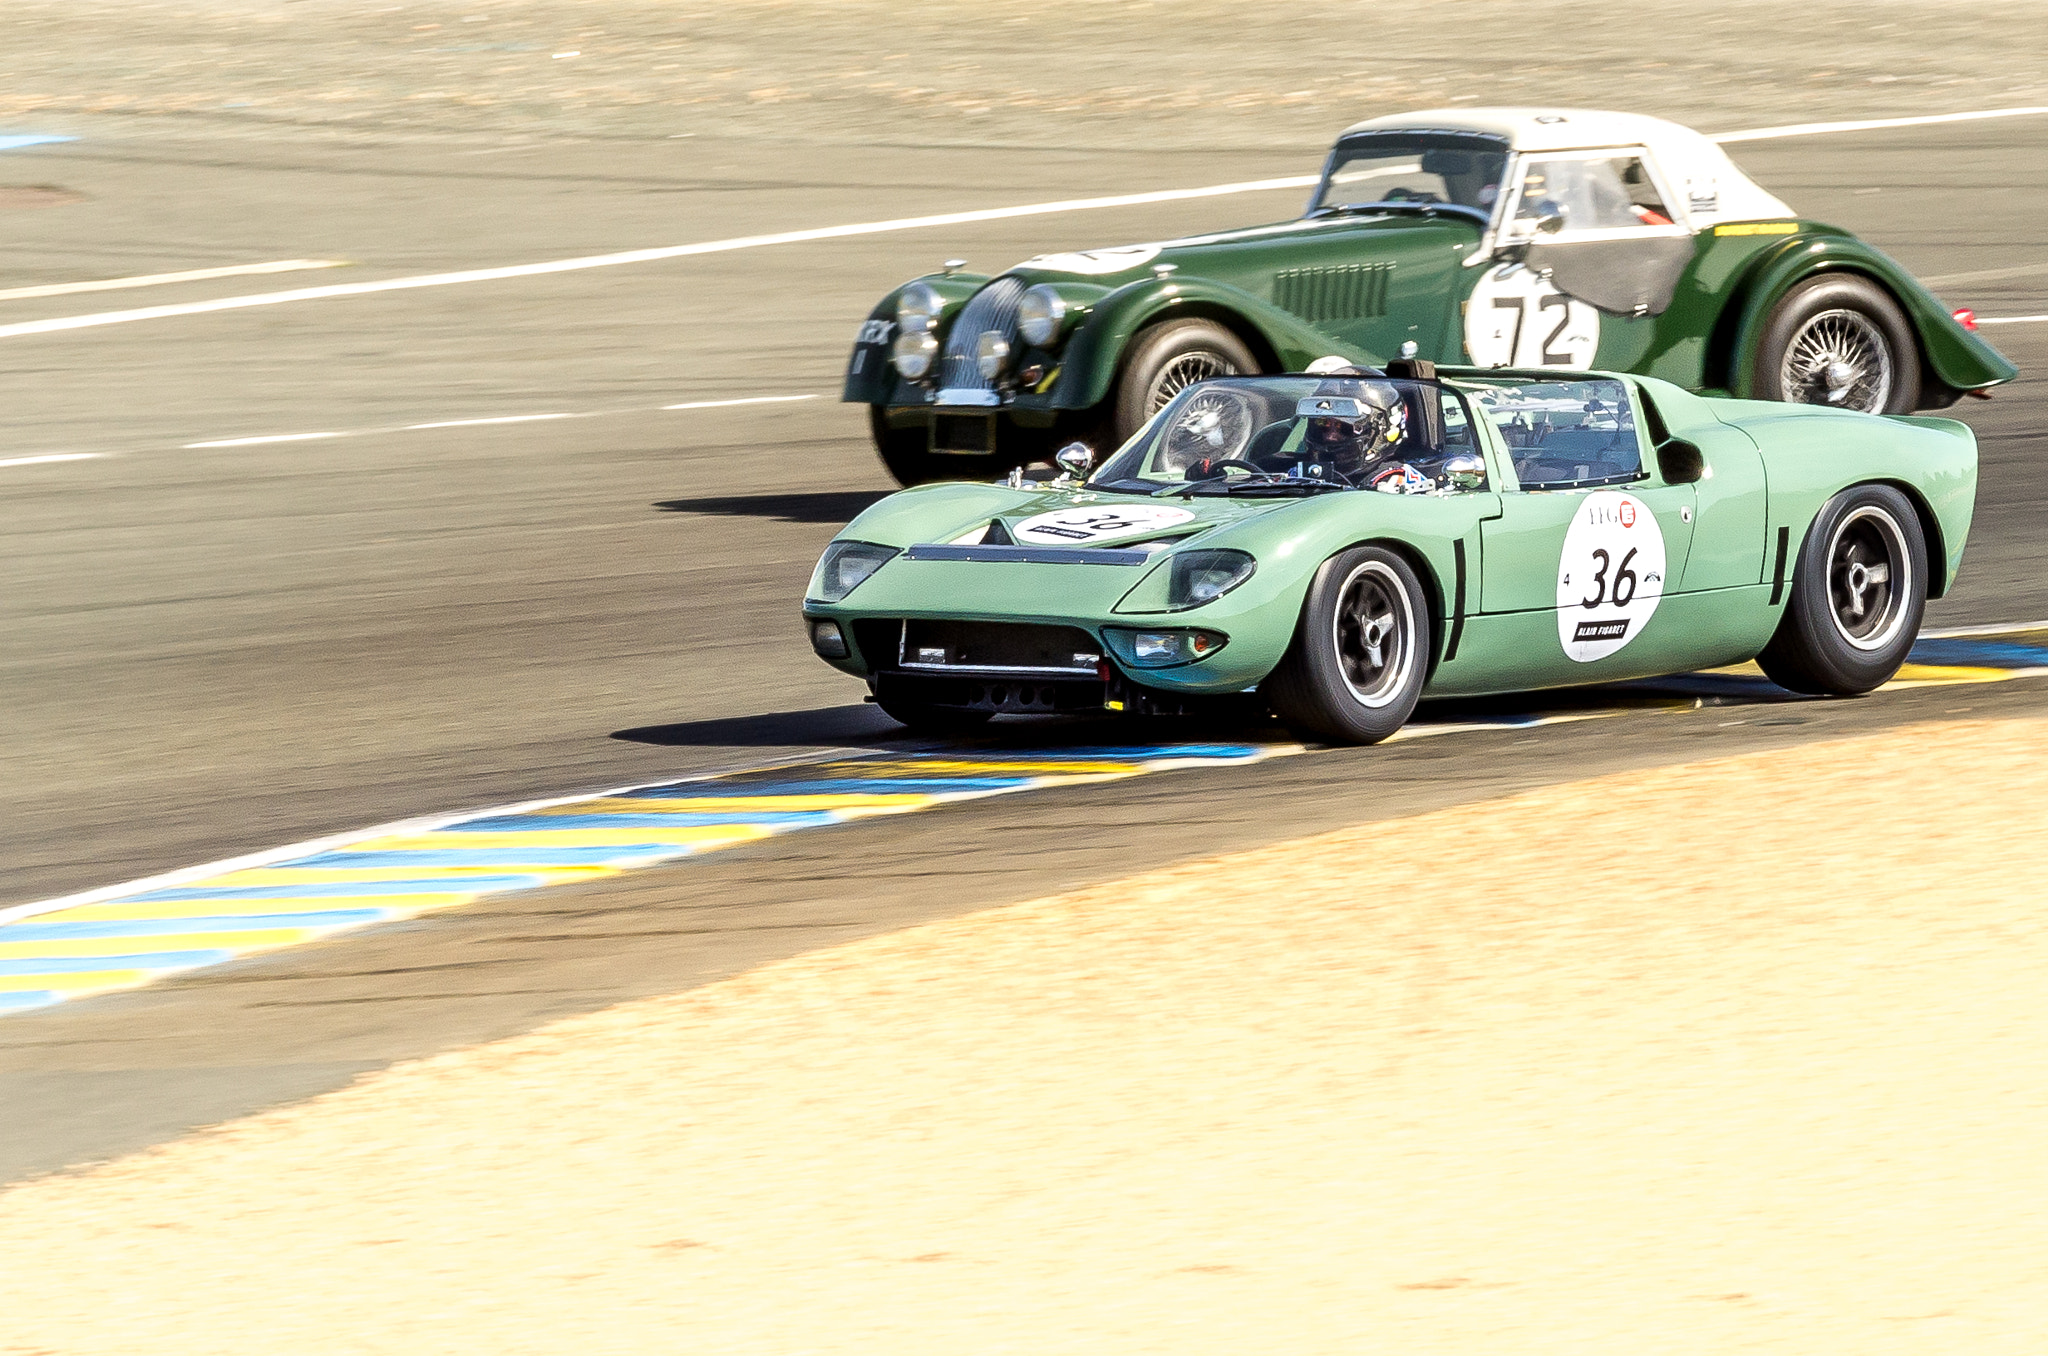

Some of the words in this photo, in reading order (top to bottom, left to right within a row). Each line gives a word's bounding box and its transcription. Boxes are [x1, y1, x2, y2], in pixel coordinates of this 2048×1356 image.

[1493, 294, 1572, 367] 72
[1563, 573, 1571, 587] 4
[1582, 547, 1638, 610] 36
